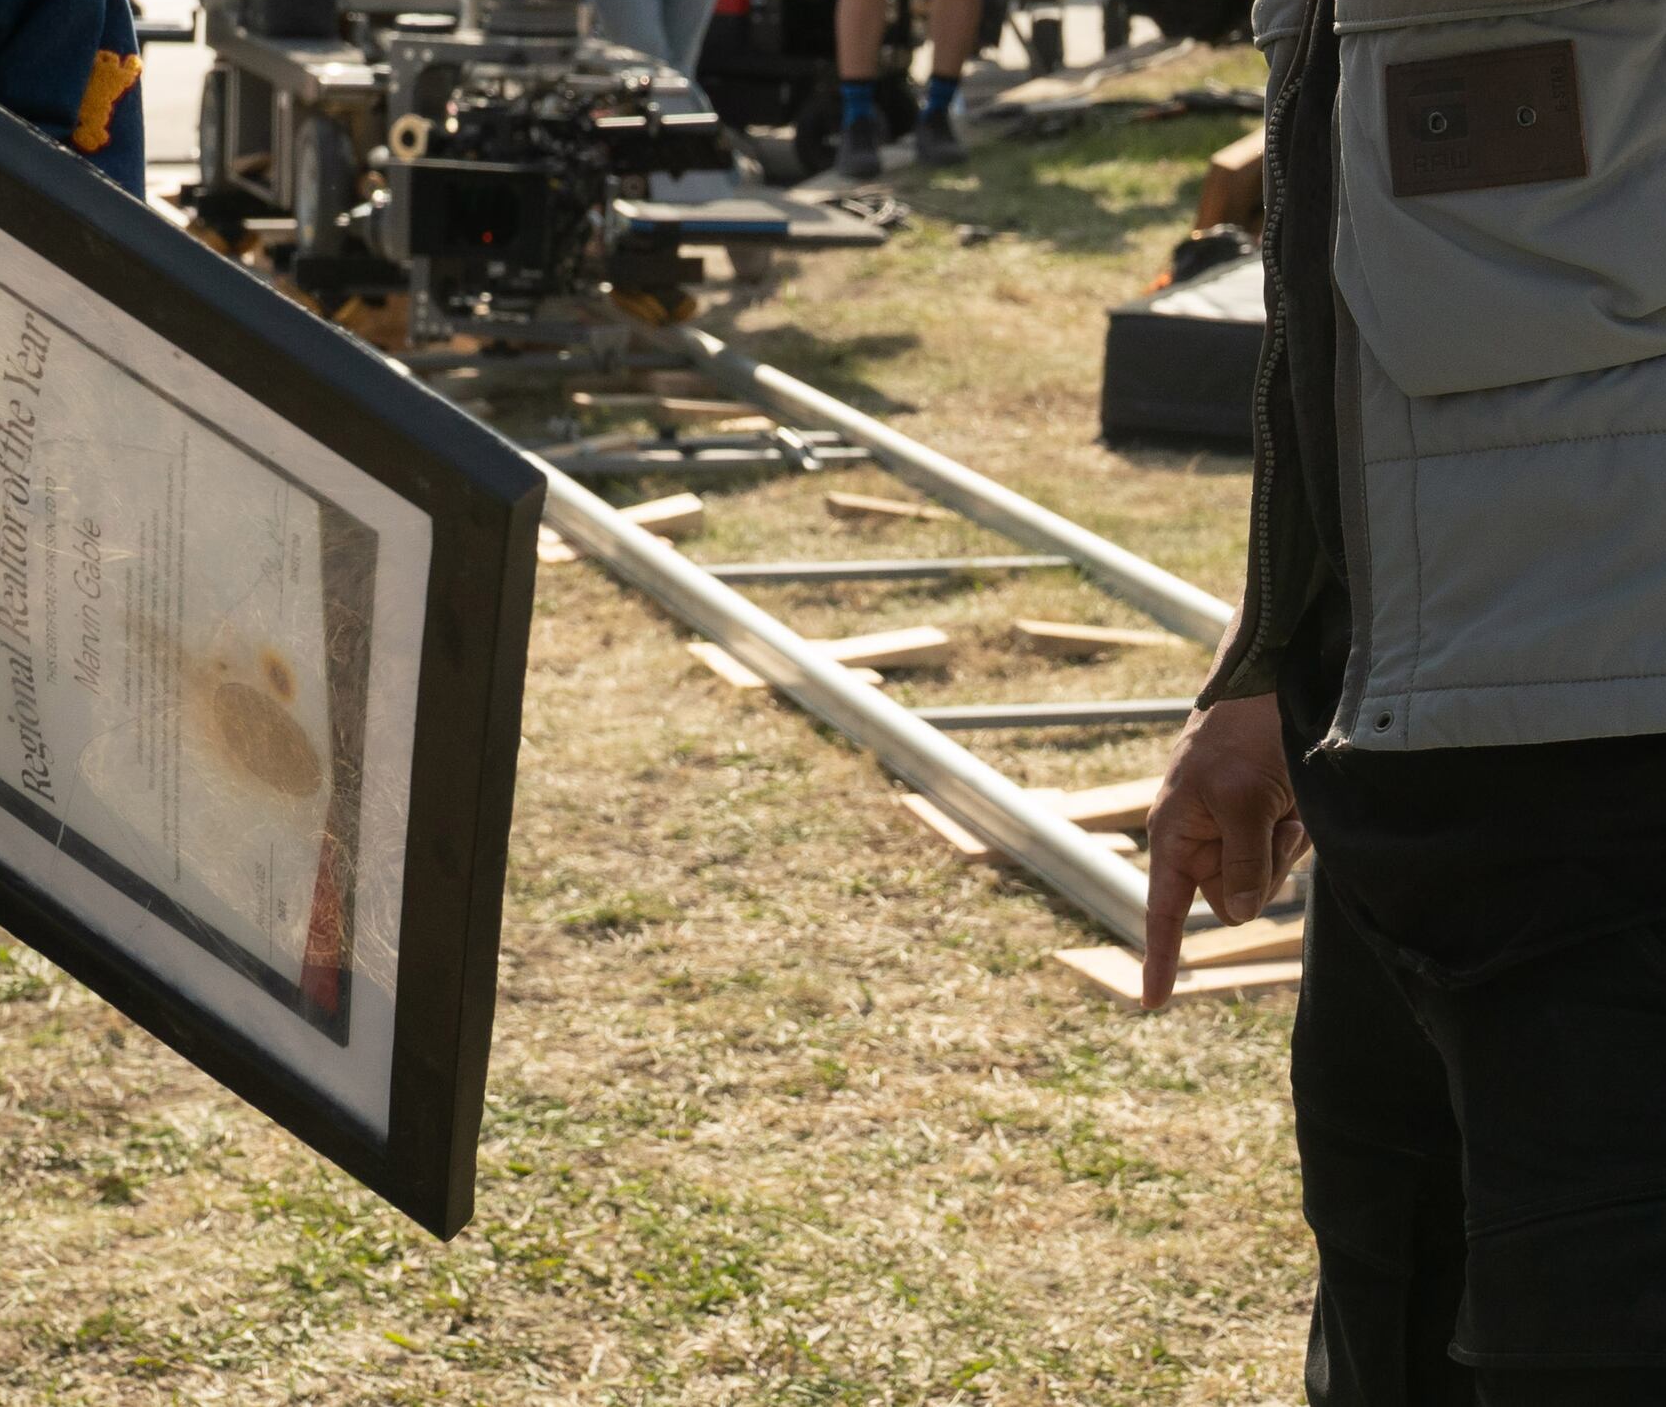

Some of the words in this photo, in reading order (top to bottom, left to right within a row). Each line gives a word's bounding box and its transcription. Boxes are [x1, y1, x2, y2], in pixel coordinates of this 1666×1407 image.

[1412, 150, 1471, 174] RAW
[3, 312, 51, 396] Year
[73, 517, 102, 599] Gable
[44, 584, 59, 657] CERTIFICATE
[73, 603, 101, 695] Marvin
[45, 658, 59, 686] THIS
